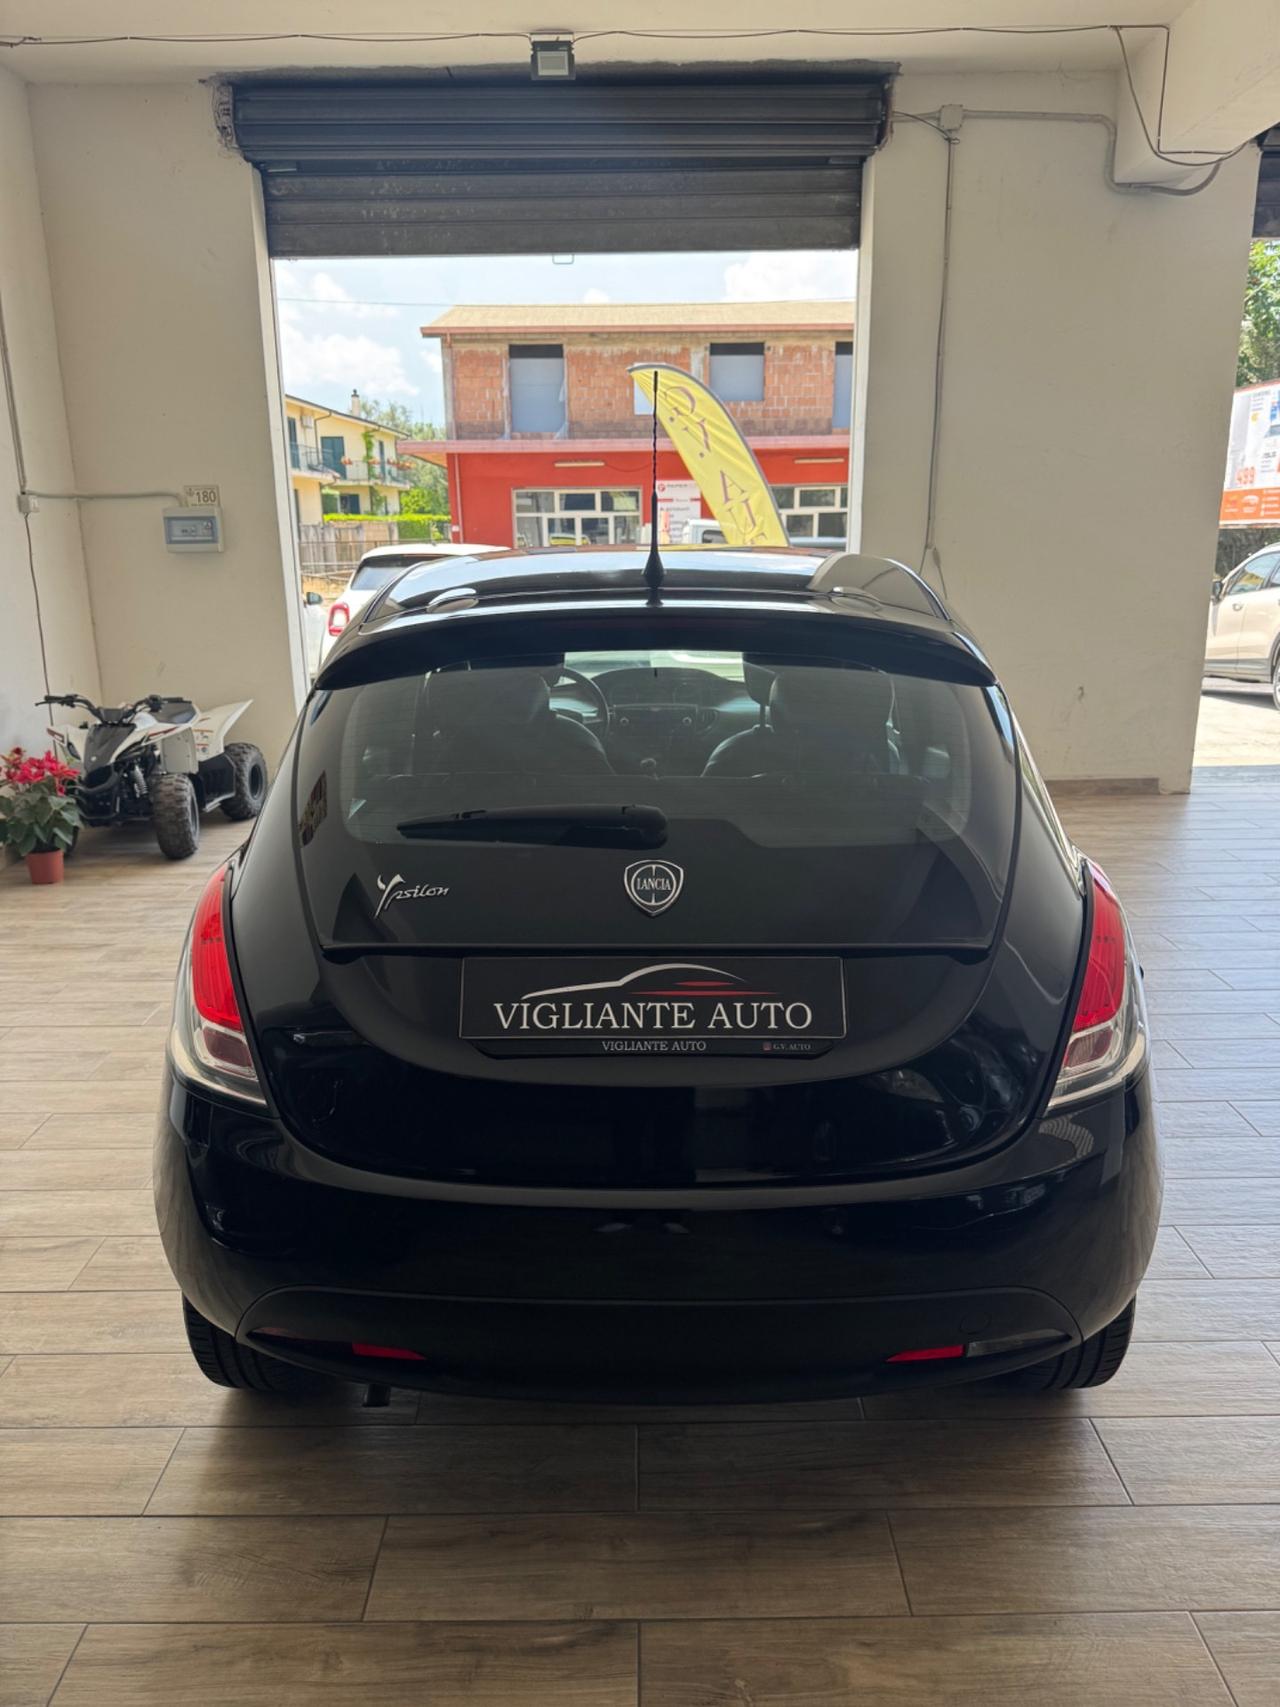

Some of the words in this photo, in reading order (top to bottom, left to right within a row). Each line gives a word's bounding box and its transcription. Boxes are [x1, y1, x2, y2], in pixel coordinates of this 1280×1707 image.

[196, 490, 217, 503] 180
[637, 877, 672, 891] LANCIA
[374, 874, 450, 919] Ypsilon
[494, 1002, 695, 1030] VIGLIANTE
[708, 1002, 812, 1030] AUTO
[602, 1041, 669, 1052] VIGLIANTE
[672, 1041, 707, 1052] AUTO
